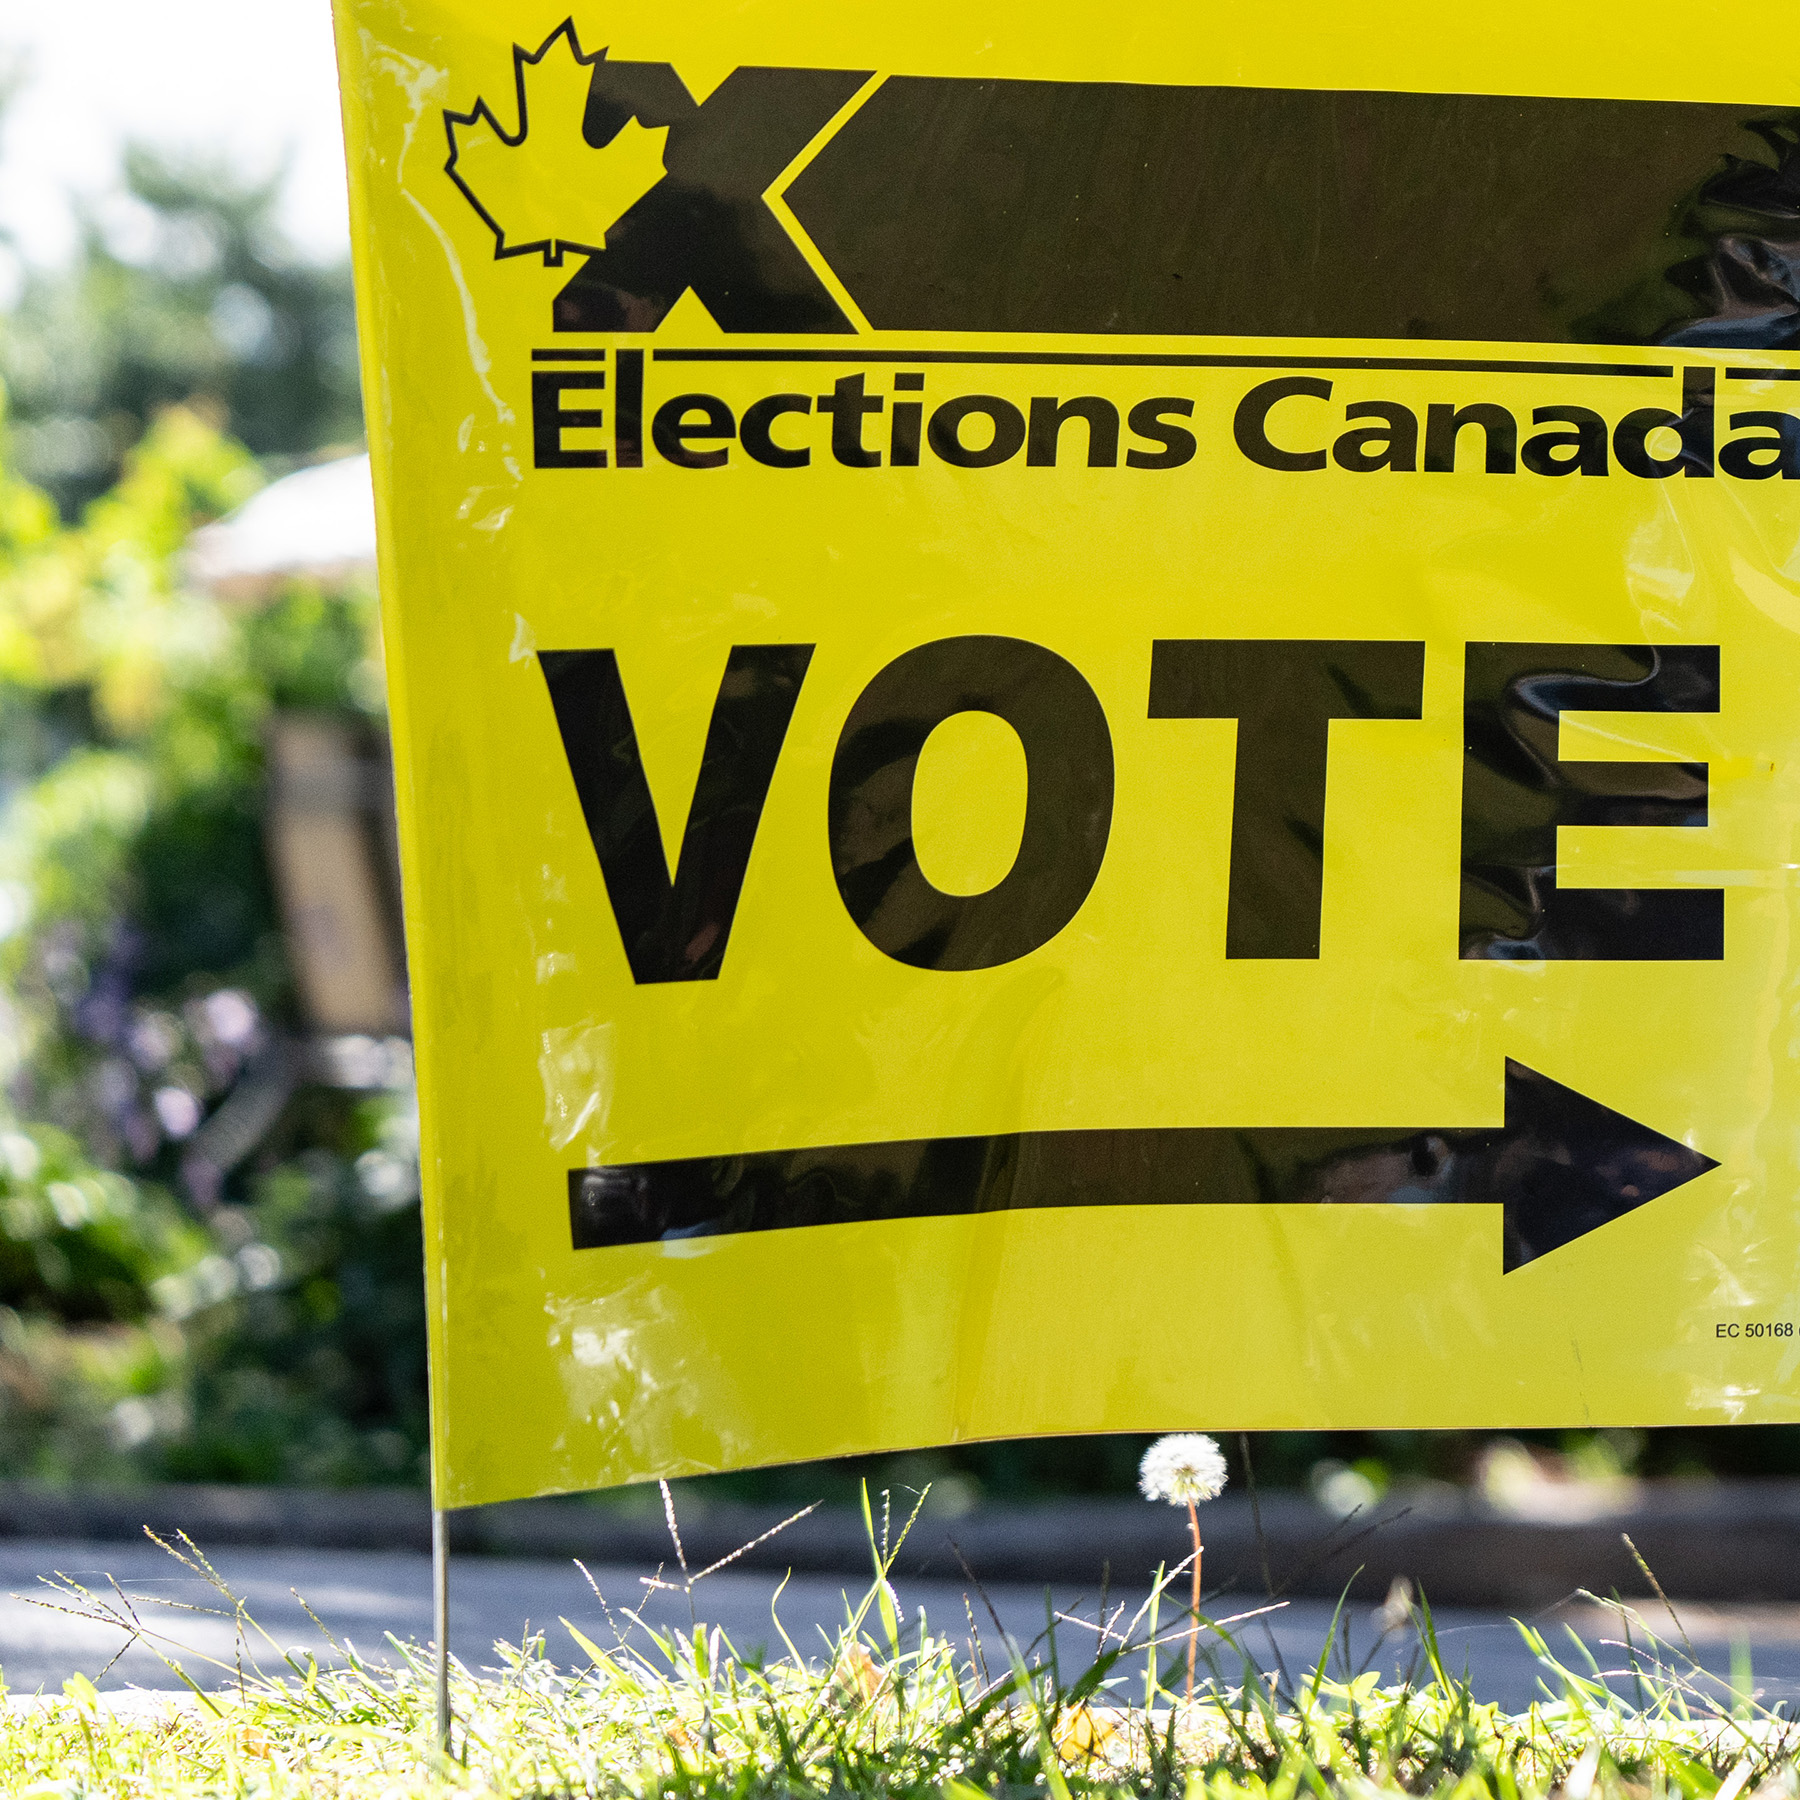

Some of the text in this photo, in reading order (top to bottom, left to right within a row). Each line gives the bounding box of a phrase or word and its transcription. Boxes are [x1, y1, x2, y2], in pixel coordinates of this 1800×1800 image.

[530, 349, 1197, 470] Elections
[537, 636, 1725, 986] VOTE
[1715, 1323, 1740, 1338] EC
[1744, 1323, 1794, 1338] 50168
